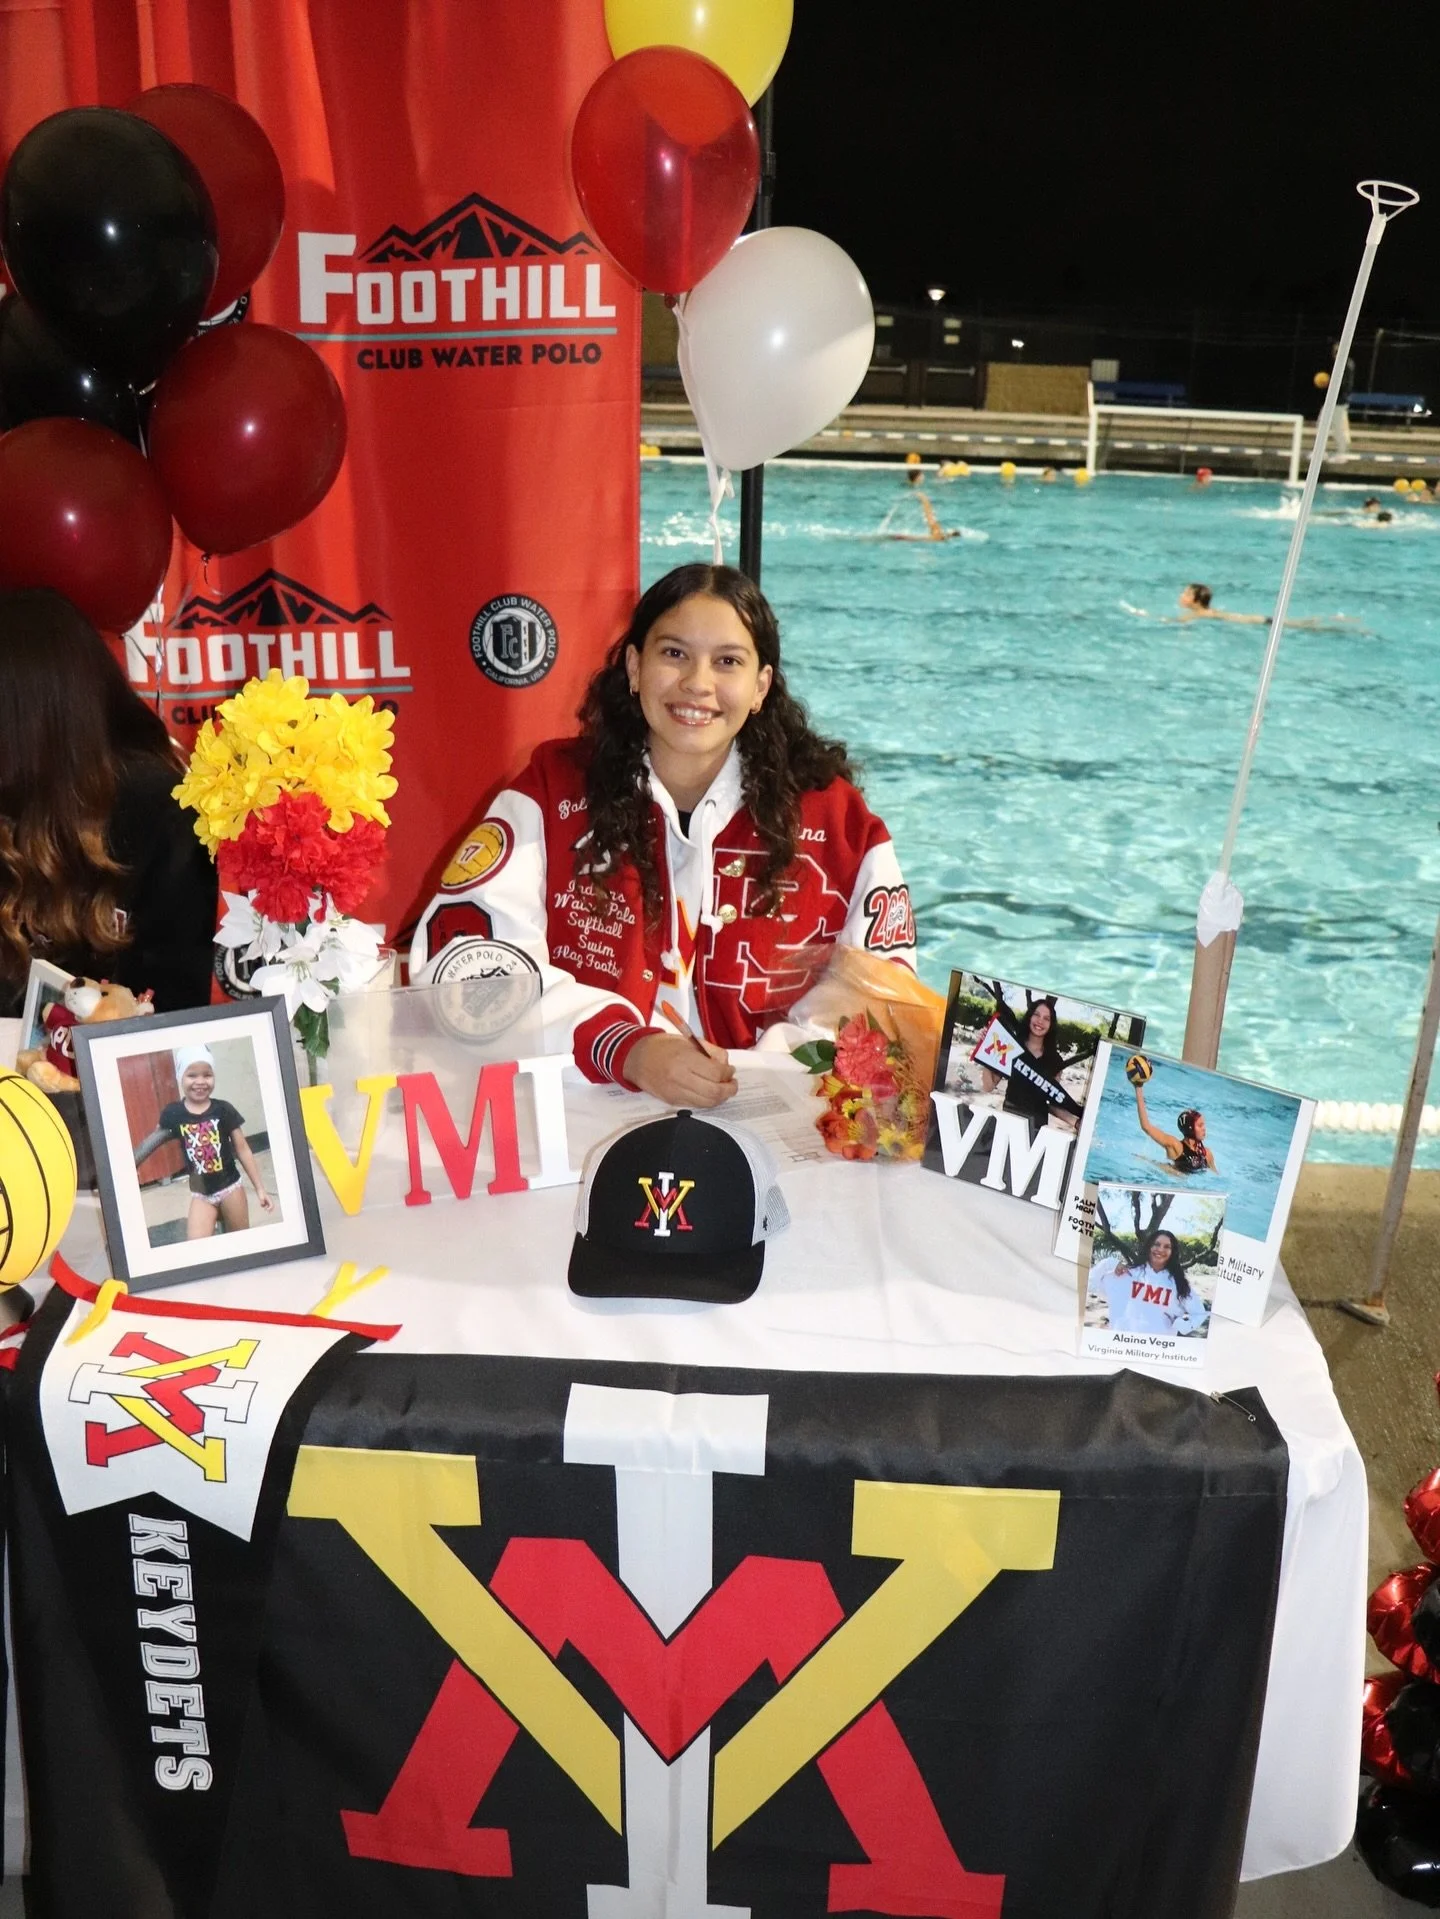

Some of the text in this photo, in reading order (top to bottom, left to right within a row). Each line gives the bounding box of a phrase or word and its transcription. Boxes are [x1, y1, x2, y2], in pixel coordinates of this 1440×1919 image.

[298, 232, 616, 324] FOOTHILL
[357, 343, 602, 370] CLUB WATER POLO
[471, 597, 556, 660] FOOTHILL CLUB WATER POLO
[171, 705, 223, 725] CLU
[558, 797, 588, 820] Pal
[567, 911, 623, 939] Softball
[608, 902, 635, 925] Polo
[552, 945, 583, 969] Flag
[578, 934, 615, 958] Swim
[447, 953, 474, 979] WATER
[1013, 1058, 1066, 1104] KEYDETS
[300, 1053, 584, 1216] VMI
[930, 1091, 1077, 1210] VM
[1074, 1195, 1096, 1209] PALM
[1068, 1215, 1095, 1230] FOOTH
[1072, 1224, 1095, 1237] WATE
[1219, 1268, 1243, 1285] itute
[1228, 1257, 1265, 1281] Military
[1131, 1281, 1172, 1306] VMI
[1088, 1344, 1198, 1362] Virginia Military Institute
[1112, 1334, 1176, 1349] Alaina Vega
[128, 1513, 213, 1791] KEYDETS
